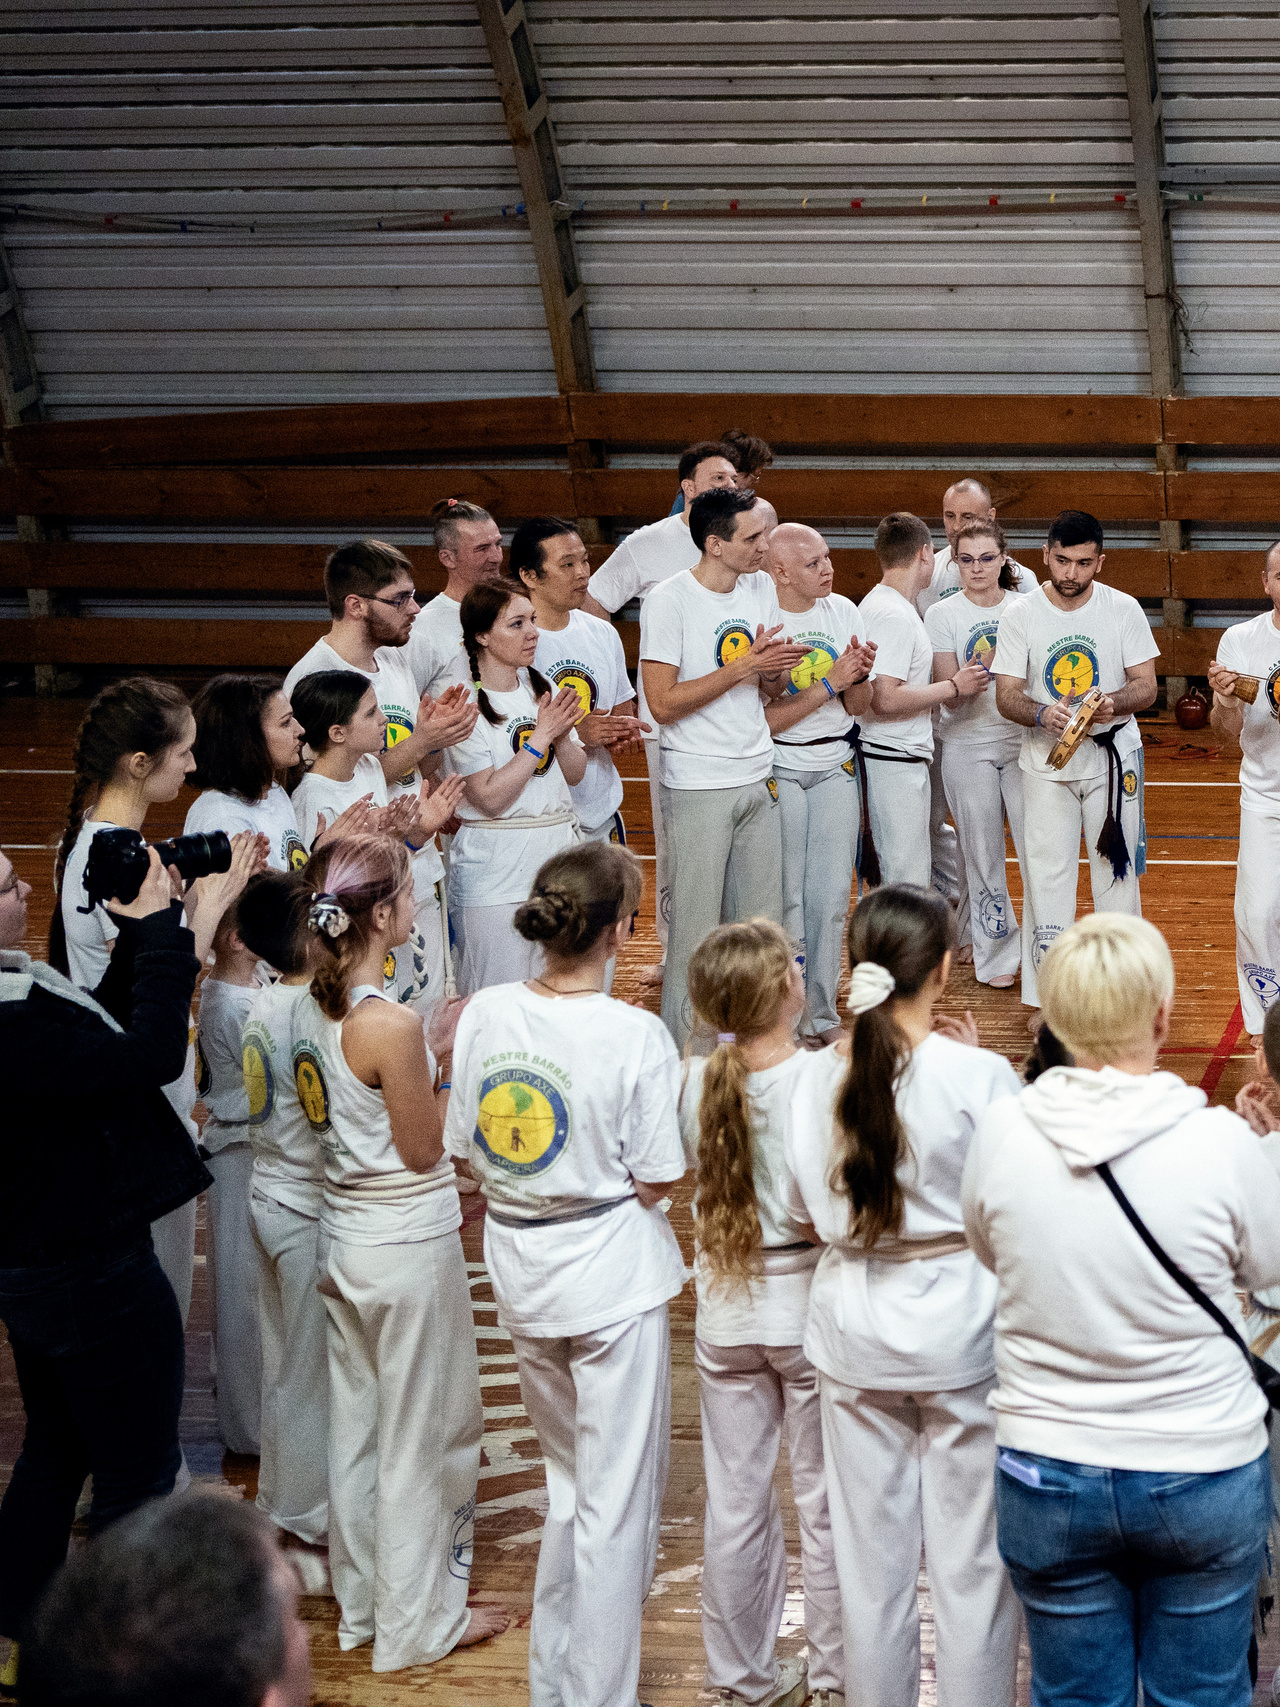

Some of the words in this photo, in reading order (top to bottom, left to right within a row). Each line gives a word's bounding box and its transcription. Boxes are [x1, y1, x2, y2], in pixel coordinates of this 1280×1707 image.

[1047, 635, 1073, 653] MESTRE
[545, 660, 565, 677] ESTRE
[482, 1051, 528, 1069] MESTRE
[489, 1070, 532, 1086] GRUPO
